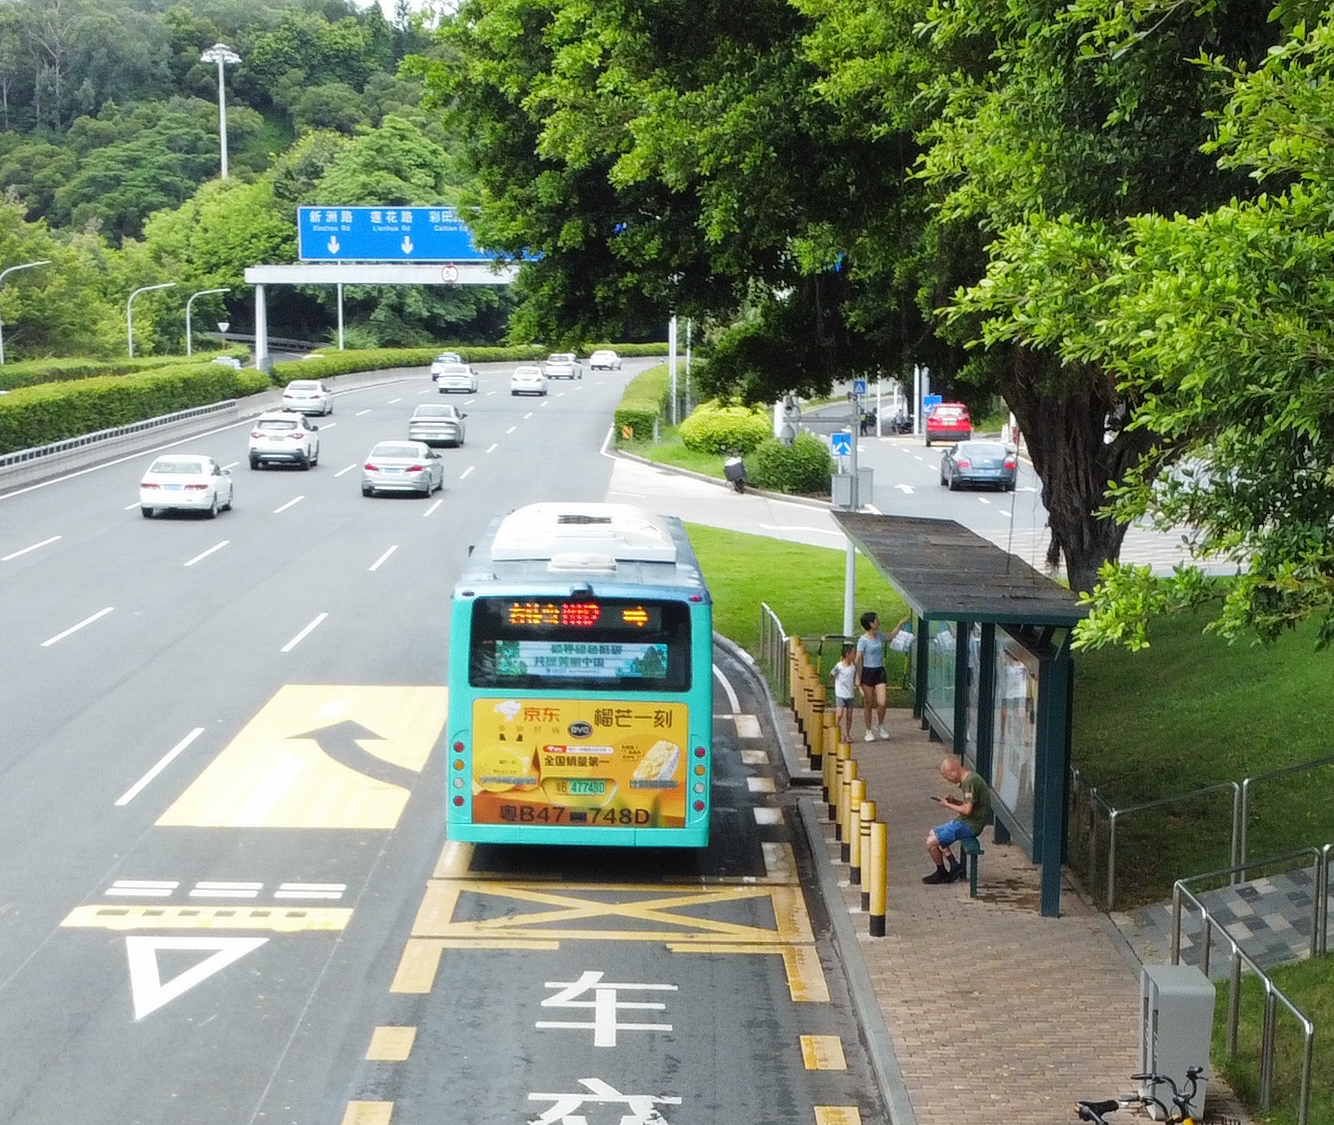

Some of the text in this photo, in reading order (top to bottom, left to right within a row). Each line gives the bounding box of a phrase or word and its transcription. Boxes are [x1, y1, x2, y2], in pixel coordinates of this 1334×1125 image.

[309, 210, 353, 223] 新洲路
[428, 210, 465, 223] 彩田
[523, 707, 561, 723] 京东
[594, 708, 673, 729] 榴芒一刻
[500, 804, 651, 825] 粤B47 748D
